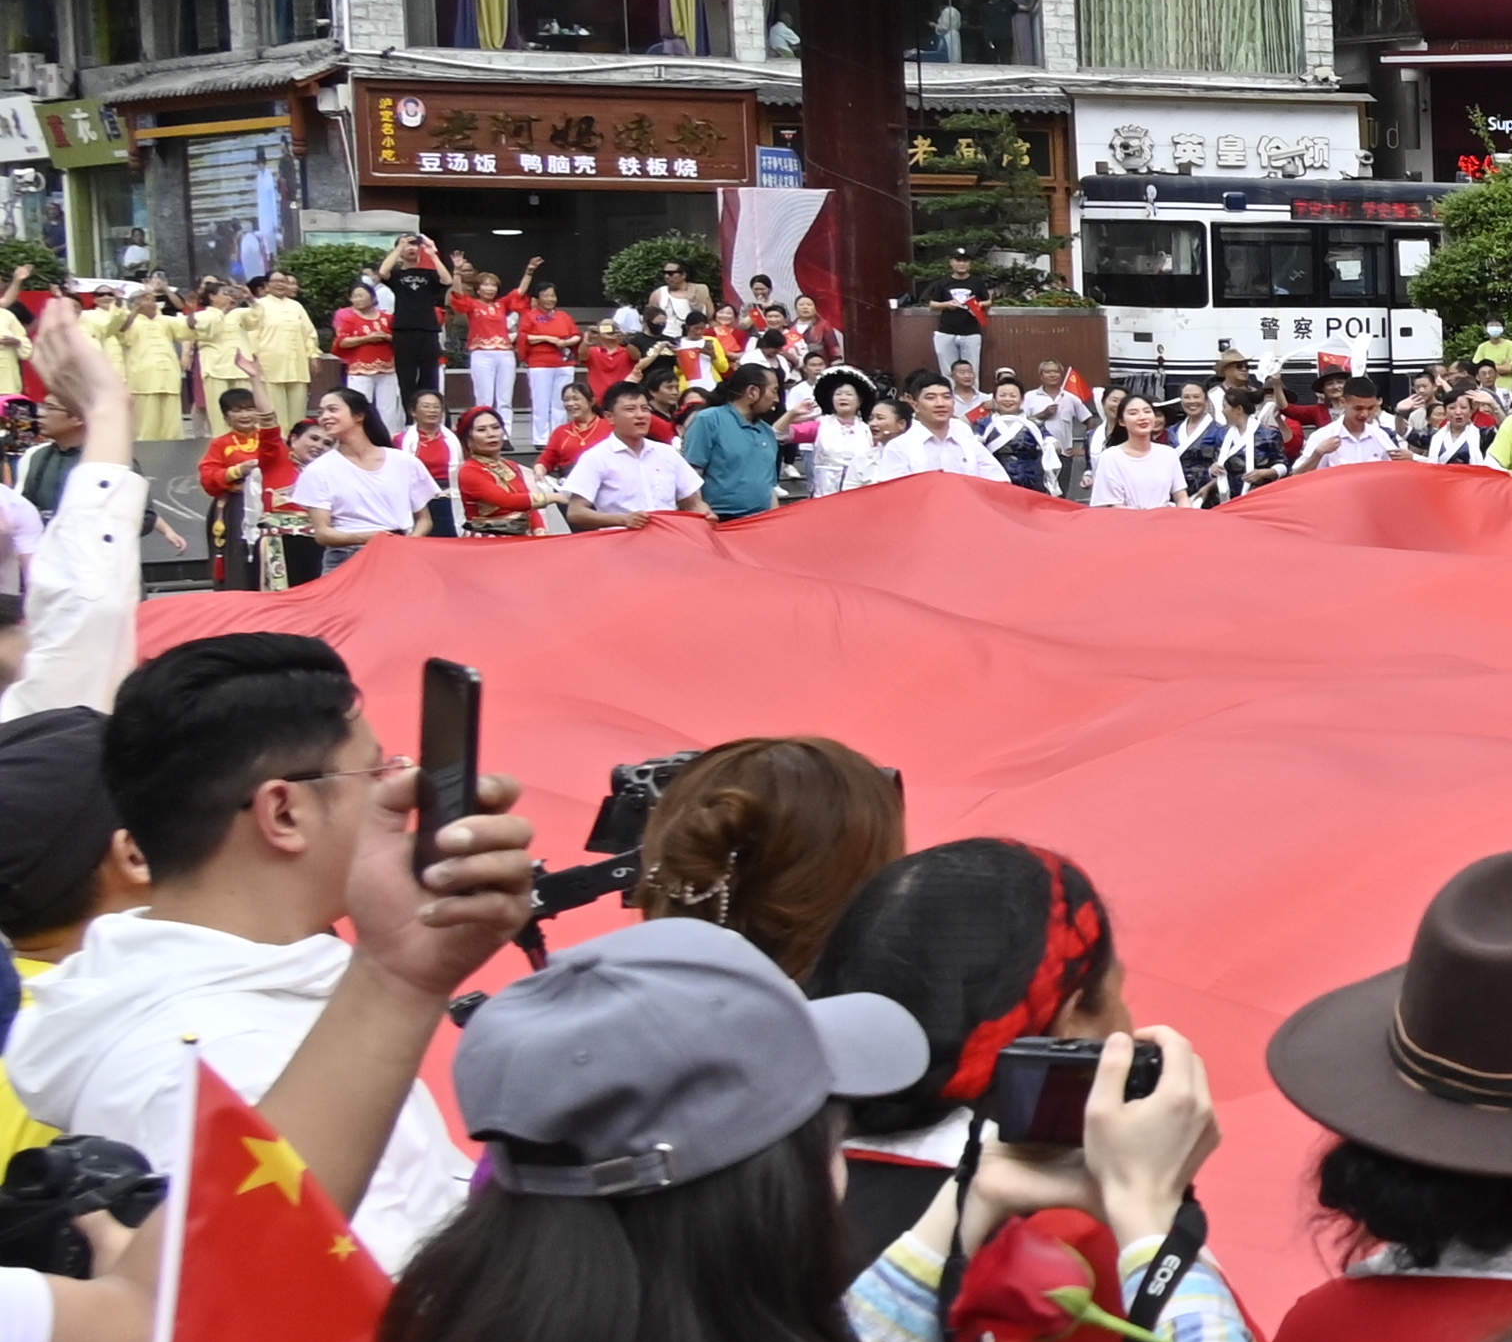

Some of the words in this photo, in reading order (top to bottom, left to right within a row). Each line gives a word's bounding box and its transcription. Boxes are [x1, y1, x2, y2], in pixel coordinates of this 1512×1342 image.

[419, 153, 498, 174] 豆汤饭
[519, 154, 597, 175] 鸭脑壳
[617, 156, 699, 178] 铁板烧
[1260, 317, 1314, 341] 警察
[1146, 1253, 1182, 1297] EOS
